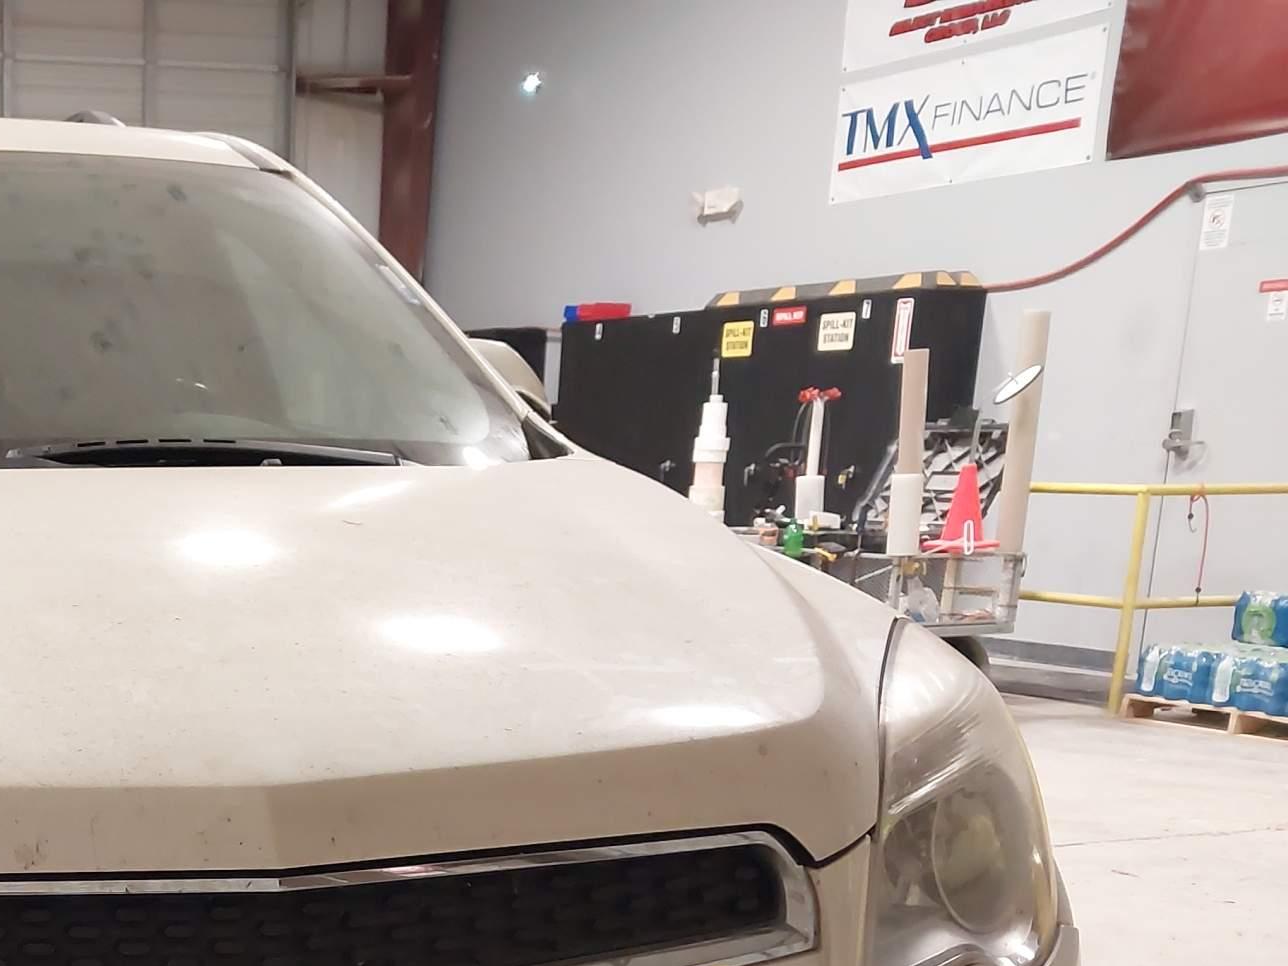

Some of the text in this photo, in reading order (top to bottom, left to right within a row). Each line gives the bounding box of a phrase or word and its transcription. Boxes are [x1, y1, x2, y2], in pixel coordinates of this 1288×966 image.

[842, 74, 1089, 159] TMX FINANCE
[822, 318, 853, 330] SPILL-KIT
[725, 327, 752, 338] SPILL-KIT
[823, 332, 849, 344] STATION
